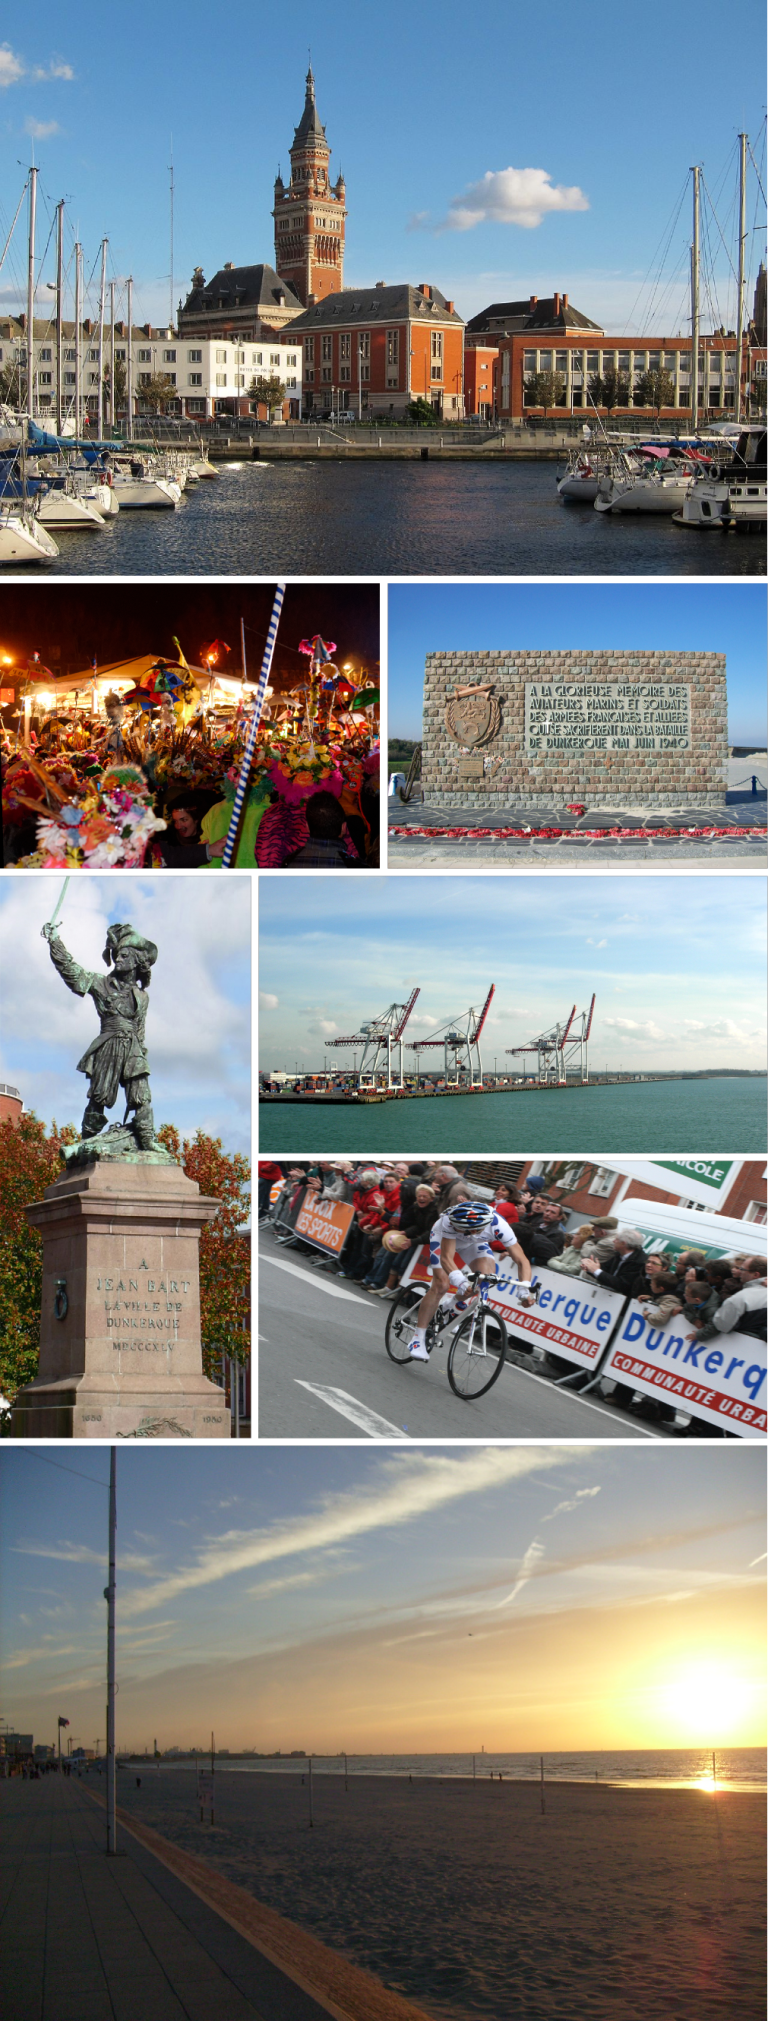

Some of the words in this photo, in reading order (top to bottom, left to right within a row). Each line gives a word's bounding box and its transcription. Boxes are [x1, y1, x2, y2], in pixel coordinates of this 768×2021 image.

[529, 686, 537, 697] A
[541, 686, 551, 697] LA
[555, 686, 612, 697] GLORIEUSE
[617, 686, 665, 697] MEMOIRE
[669, 686, 687, 697] DES
[530, 699, 583, 710] AVIATEURS
[586, 699, 624, 710] MARINS
[628, 699, 640, 710] ET
[642, 699, 687, 710] SOLDATS
[530, 712, 547, 723] DES
[549, 712, 586, 723] ARMEES
[643, 712, 654, 723] ET
[654, 712, 688, 723] ALLIEES
[563, 725, 620, 736] SACRIFIERENT
[620, 725, 643, 736] DANS
[644, 725, 653, 736] LA
[655, 725, 688, 736] BATAILLE
[529, 738, 543, 749] DE
[546, 738, 607, 749] DUNKERQUE
[612, 738, 629, 749] MAI
[634, 738, 655, 749] JUIN
[659, 738, 688, 749] 1940
[670, 1160, 724, 1181] ICOLE
[307, 1218, 342, 1246] SPORTS
[139, 1258, 148, 1269] A
[97, 1278, 138, 1291] JEAN
[148, 1280, 190, 1293] BART
[166, 1302, 182, 1312] DE
[106, 1318, 180, 1330] DUNKERQUE
[486, 1300, 546, 1333] MMUNAUTÉ
[546, 1326, 599, 1357] URBAINE
[613, 1355, 716, 1405] COMMUNAUTÉ
[718, 1398, 768, 1430] URBA
